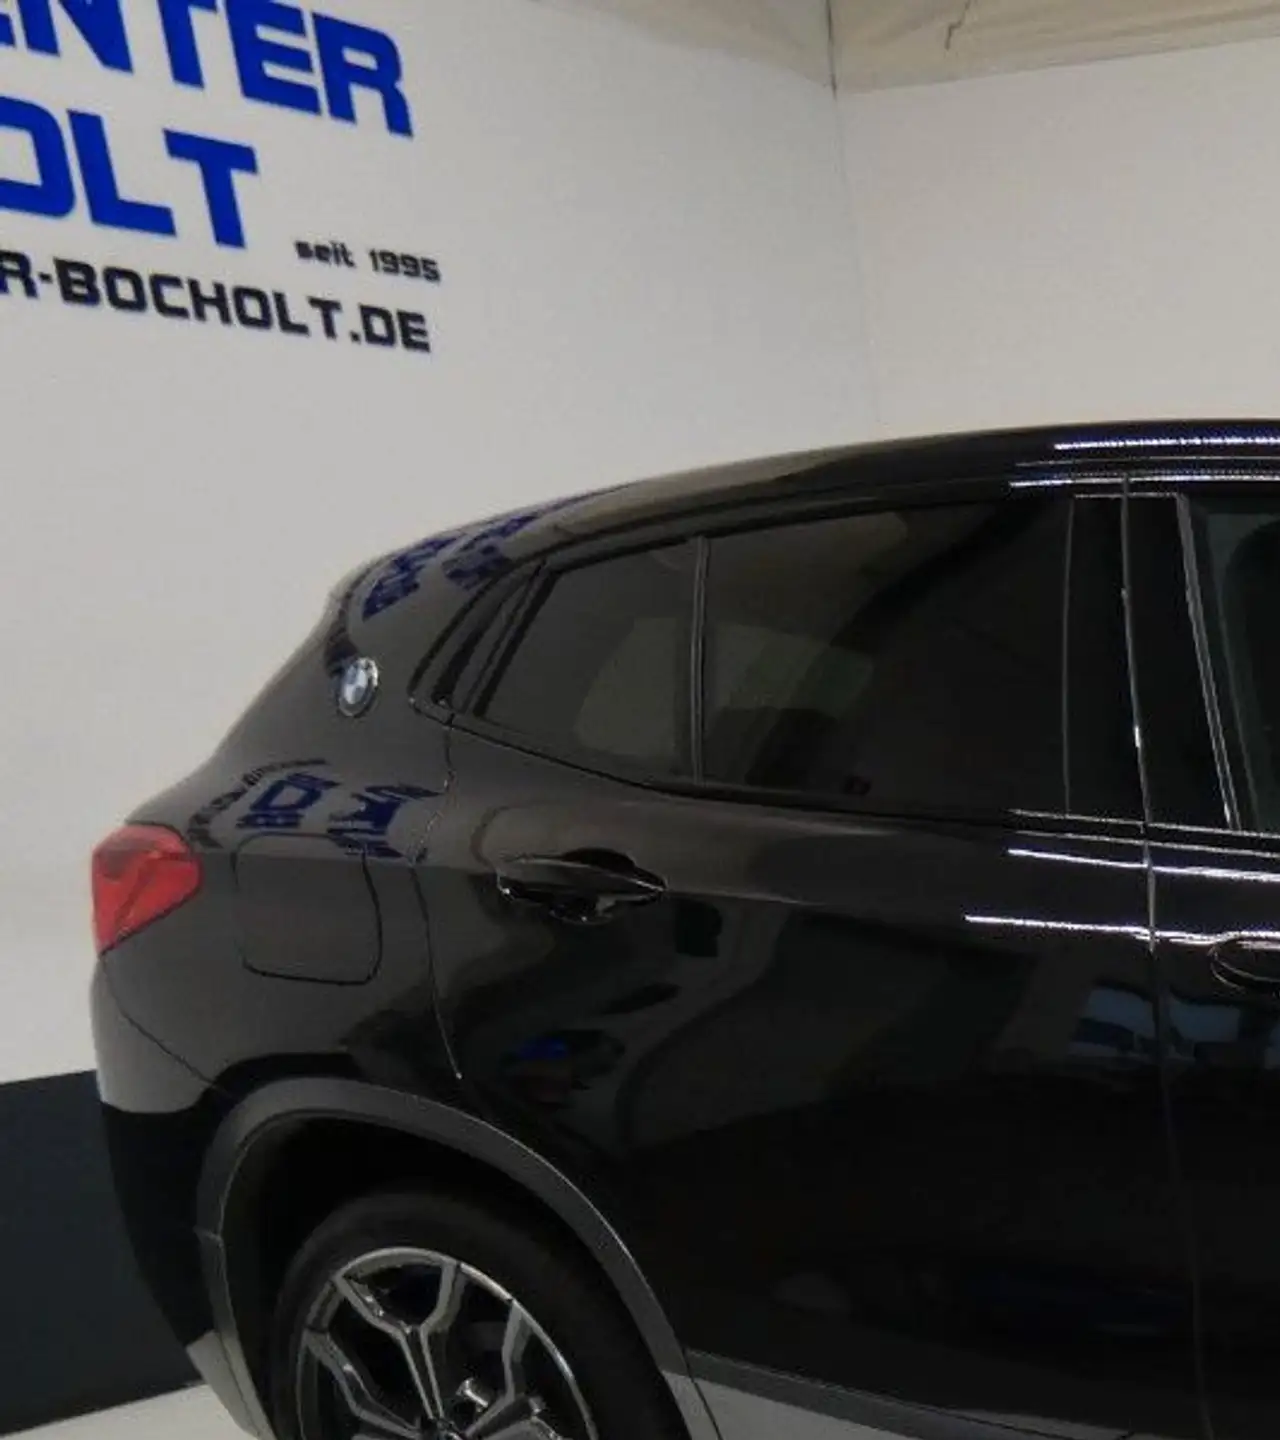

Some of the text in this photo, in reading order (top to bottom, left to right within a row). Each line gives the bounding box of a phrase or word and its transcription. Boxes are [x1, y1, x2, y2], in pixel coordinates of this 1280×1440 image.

[0, 0, 413, 137] NTER
[294, 240, 356, 269] seit
[368, 248, 442, 284] 1995
